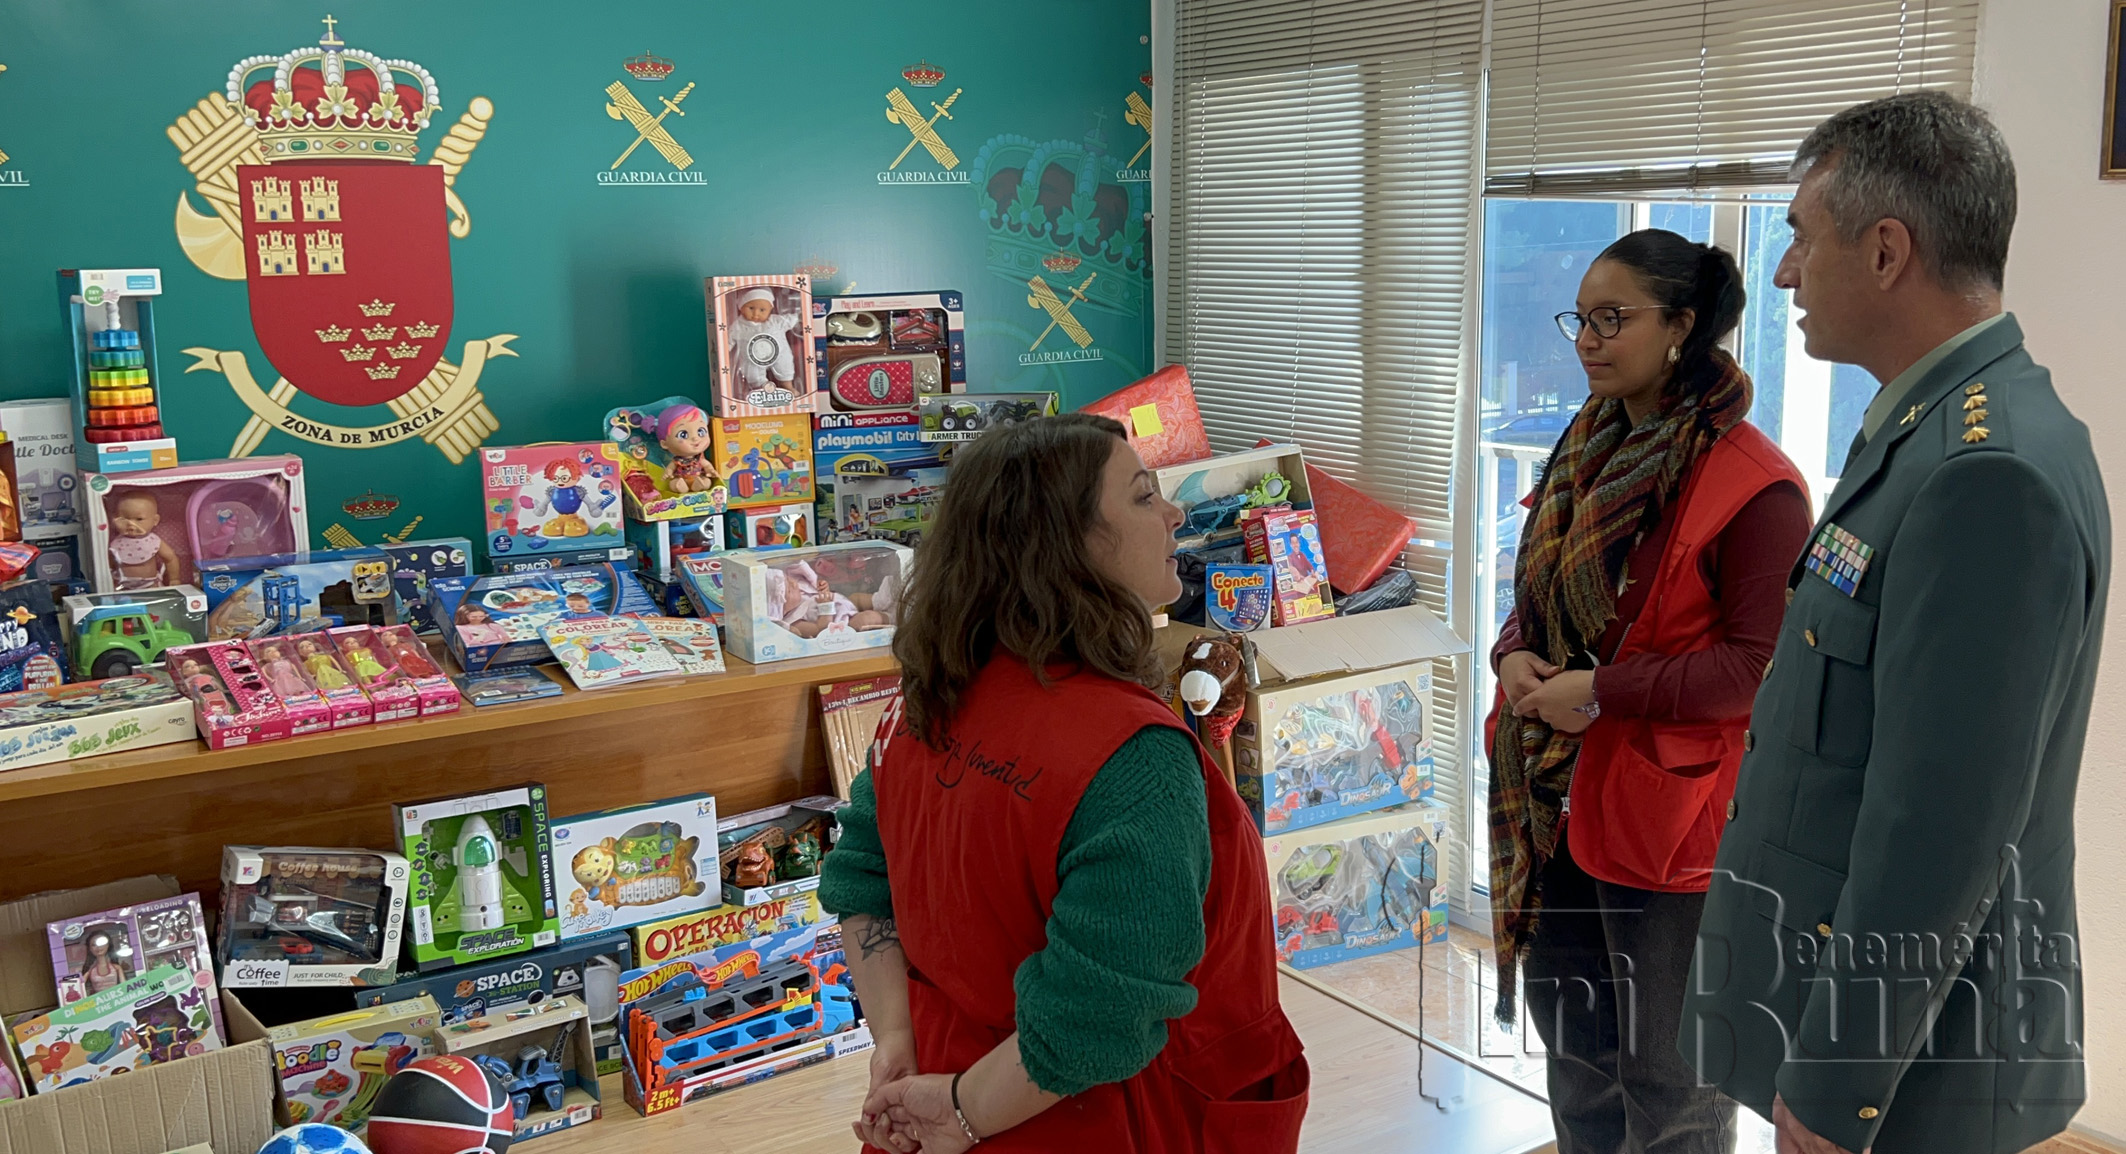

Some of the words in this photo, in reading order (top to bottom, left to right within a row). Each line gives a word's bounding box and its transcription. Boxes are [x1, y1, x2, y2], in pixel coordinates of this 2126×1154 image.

[597, 171, 666, 183] GUARDIA
[668, 171, 708, 183] CIVIL
[877, 171, 935, 183] GUARDIA
[937, 171, 971, 183] CIVIL
[1019, 351, 1071, 363] GUARDIA
[1073, 348, 1103, 359] CIVIL
[750, 392, 792, 404] Elaine
[281, 415, 334, 442] ZONA
[340, 433, 362, 444] DE
[368, 406, 445, 443] MURCIA
[818, 431, 892, 450] playmobil
[896, 431, 916, 443] City
[493, 464, 527, 477] LITTLE
[489, 474, 533, 486] BARBER
[514, 561, 548, 573] SPACE
[1219, 588, 1237, 611] 4
[556, 621, 630, 635] COLOREAR
[168, 716, 186, 726] cayro
[533, 802, 549, 853] SPACE
[278, 861, 319, 874] Coffee
[321, 862, 359, 873] house
[541, 854, 552, 899] EXPLORING
[459, 928, 517, 951] SPACE
[467, 937, 525, 955] EXPLORATION
[237, 967, 281, 980] Coffee
[477, 966, 535, 992] SPACE
[716, 963, 733, 981] HOT
[126, 978, 148, 993] AND
[500, 981, 540, 996] STATION
[622, 976, 653, 1003] HOT
[650, 962, 693, 990] WHEELS
[95, 1001, 113, 1014] THE
[114, 987, 150, 1007] ANIMAL
[838, 1042, 871, 1056] SPEEDWAY
